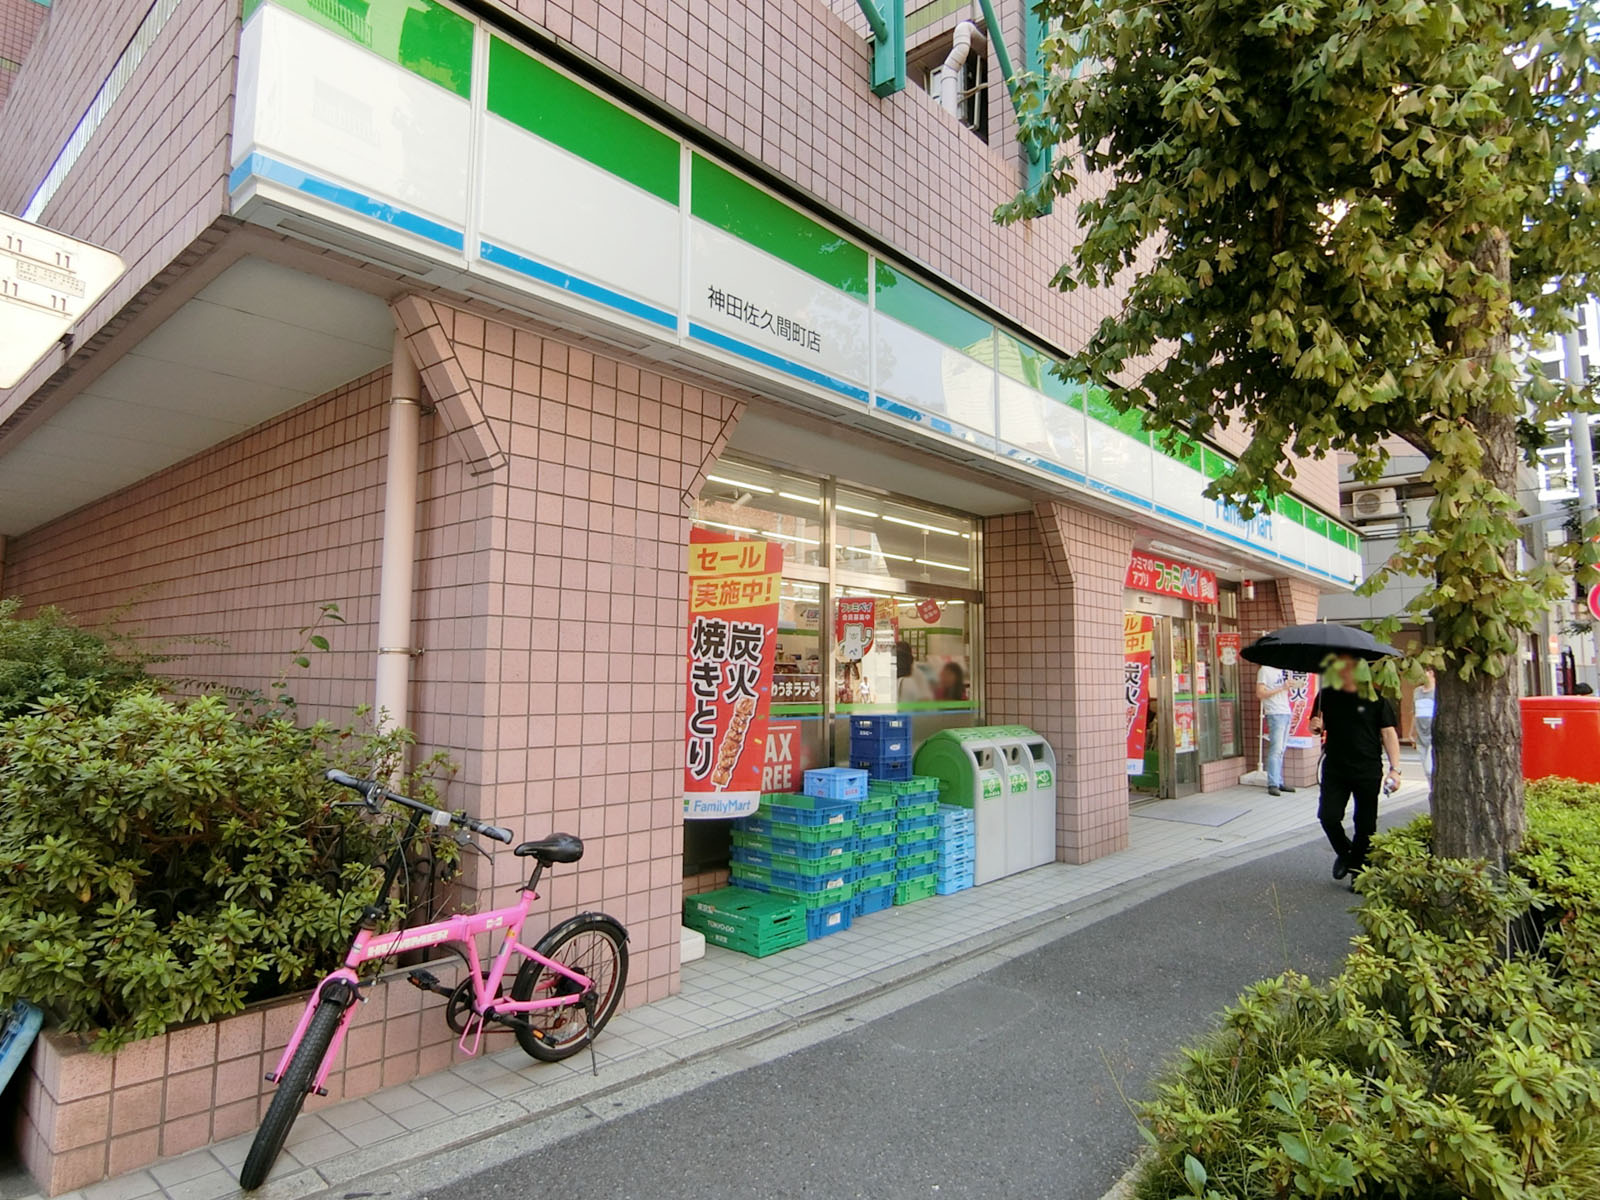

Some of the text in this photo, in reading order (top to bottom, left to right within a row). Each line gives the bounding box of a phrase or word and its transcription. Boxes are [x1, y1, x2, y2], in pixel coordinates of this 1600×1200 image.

[707, 284, 821, 353] 神田佐久間町店
[697, 546, 761, 572] セール
[725, 621, 764, 701] 炭火
[689, 617, 727, 778] 焼きとり
[693, 799, 751, 814] FamilyMart
[368, 930, 449, 957] HUMMER
